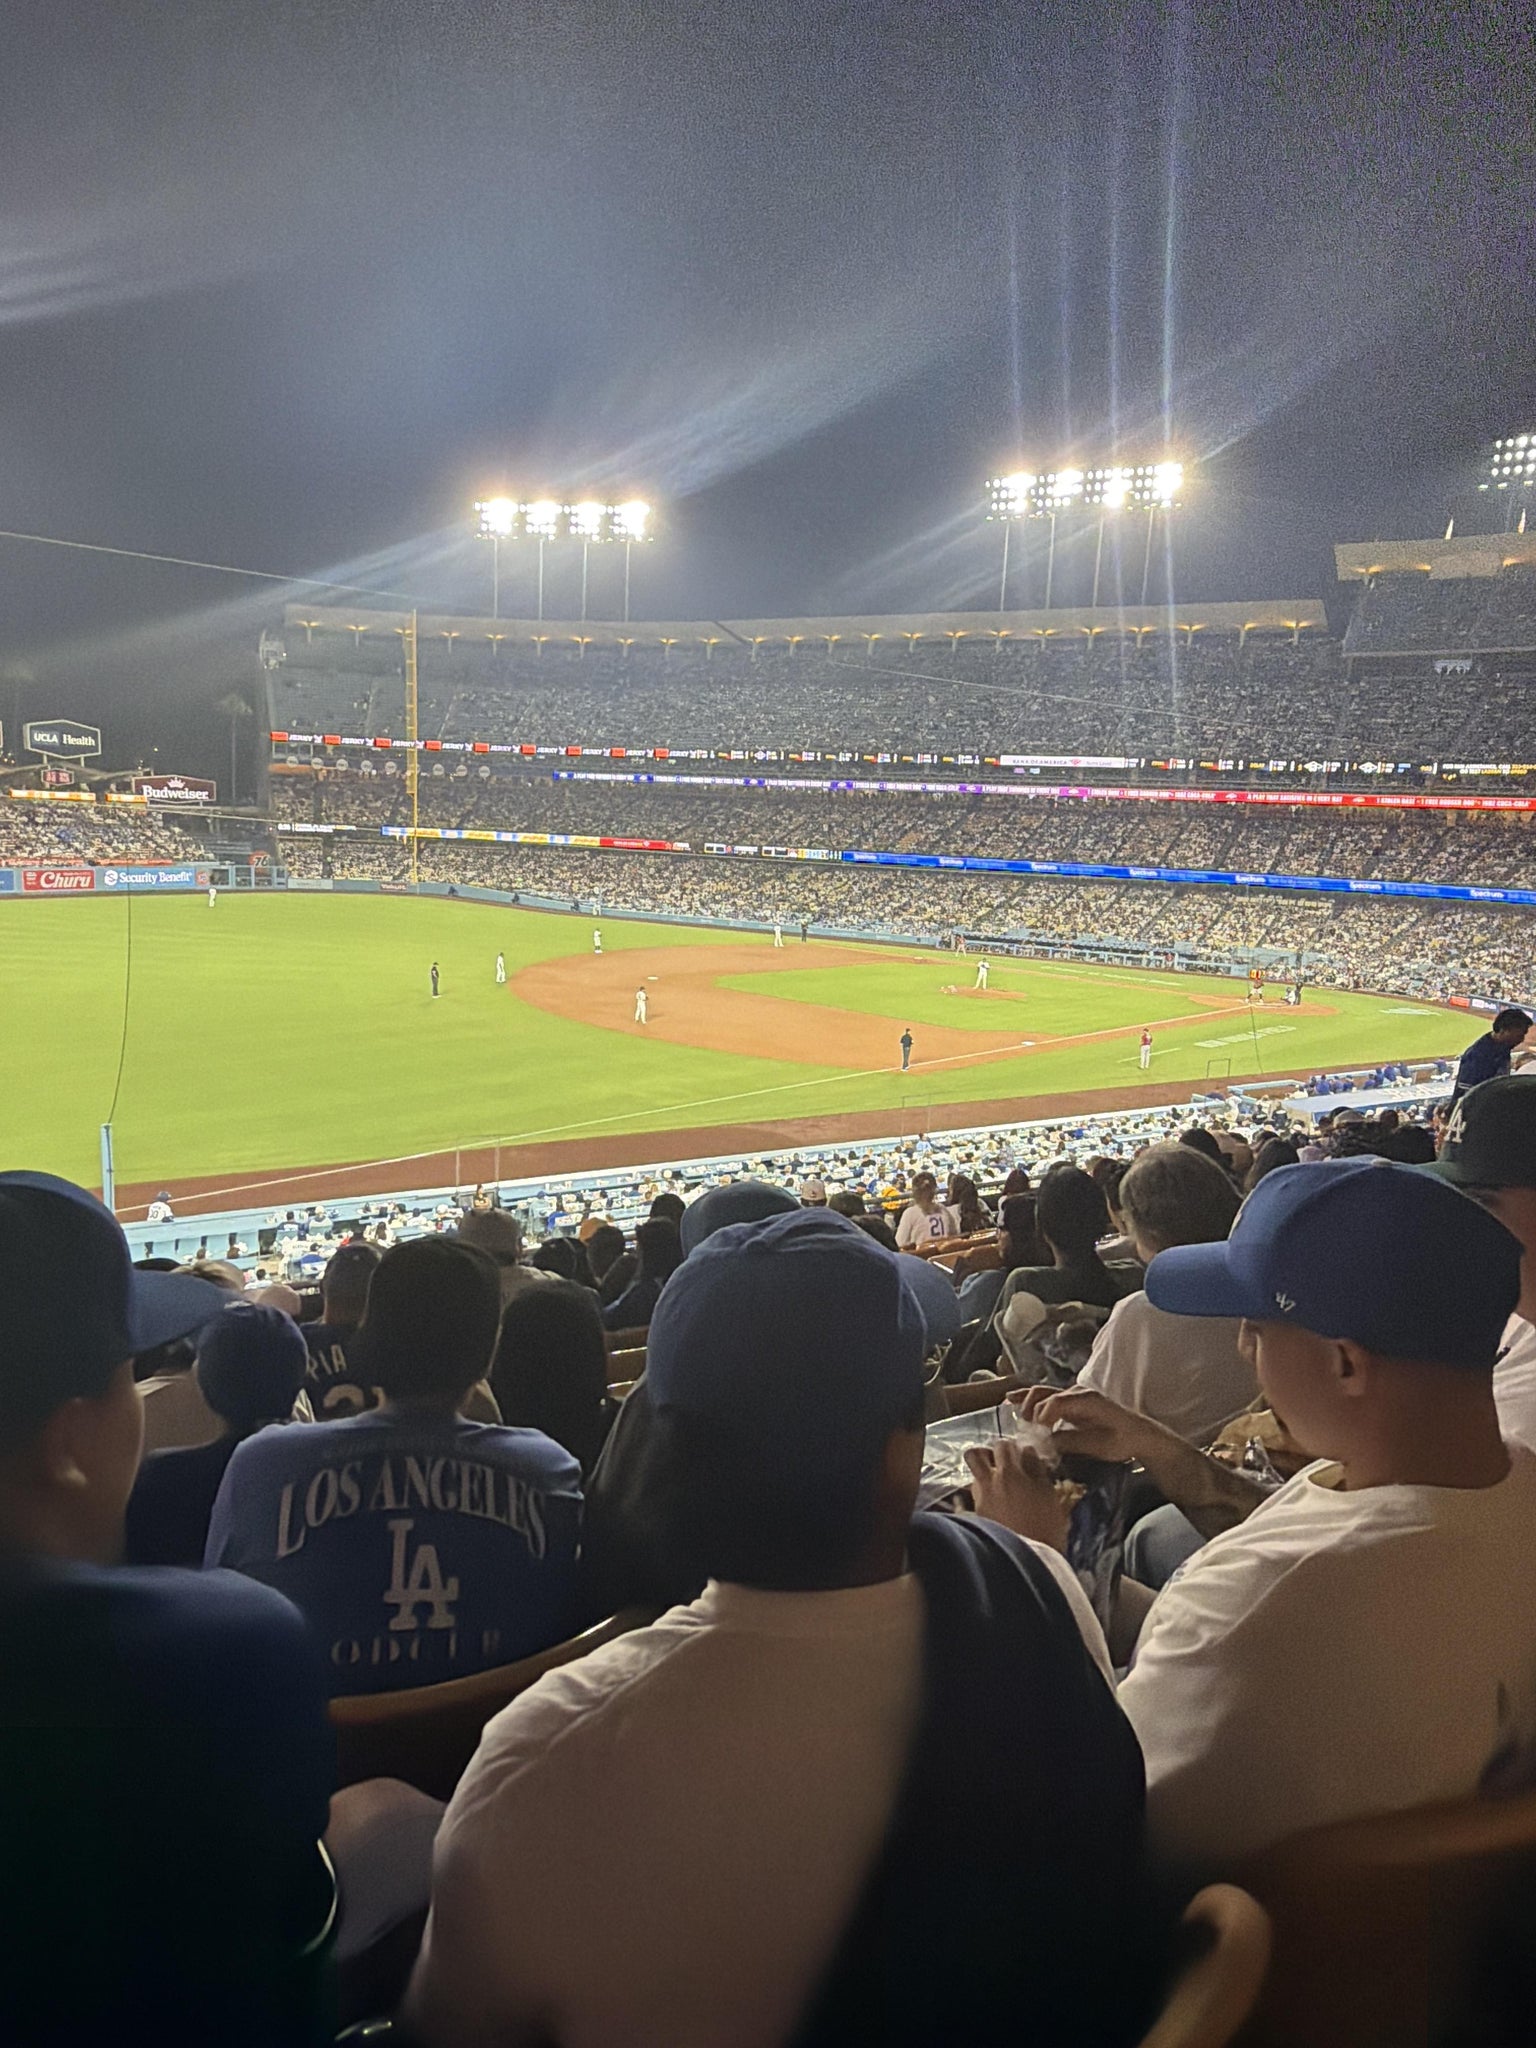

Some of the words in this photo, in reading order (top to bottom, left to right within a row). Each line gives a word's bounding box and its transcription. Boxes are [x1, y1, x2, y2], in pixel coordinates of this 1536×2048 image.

[34, 732, 58, 744] UCLA
[62, 734, 96, 747] Health
[142, 784, 209, 800] Budweiser
[254, 856, 269, 867] 76
[40, 871, 91, 888] Churu
[119, 872, 158, 884] Security
[158, 871, 191, 882] Benefit
[1470, 889, 1504, 900] Spectrum
[929, 1217, 945, 1237] 21
[276, 1458, 363, 1560] LOS
[369, 1455, 548, 1560] ANGELES
[382, 1518, 460, 1632] LA
